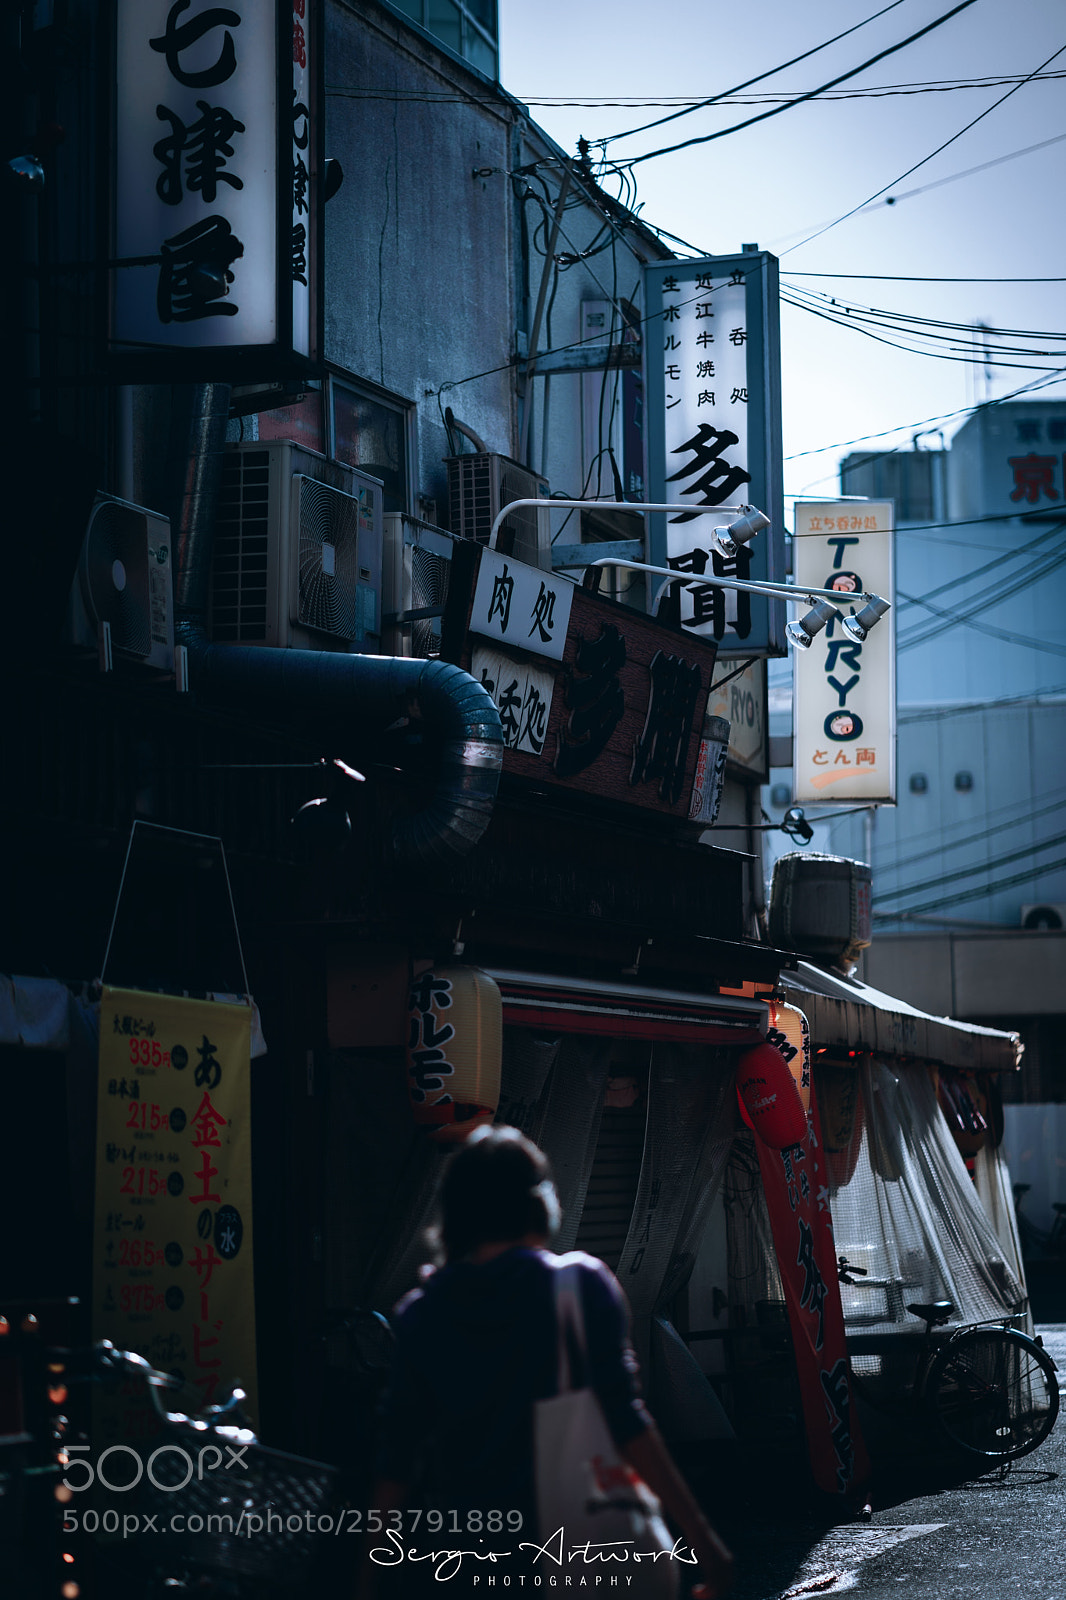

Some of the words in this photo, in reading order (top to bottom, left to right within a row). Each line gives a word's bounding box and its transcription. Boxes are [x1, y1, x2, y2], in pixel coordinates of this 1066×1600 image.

[662, 276, 682, 410] 生ホルモン
[695, 272, 716, 407] 近江牛焼肉
[728, 269, 749, 404] 立呑処
[1008, 452, 1066, 504] 京
[665, 423, 754, 641] 多聞
[809, 515, 877, 531] 立ち呑み処
[487, 563, 556, 643] 肉処
[812, 748, 876, 765] とん両
[129, 1038, 171, 1068] 335円
[126, 1101, 169, 1131] 215円
[120, 1166, 167, 1196] 215円
[119, 1238, 165, 1267] 265円
[220, 1226, 236, 1252] 水
